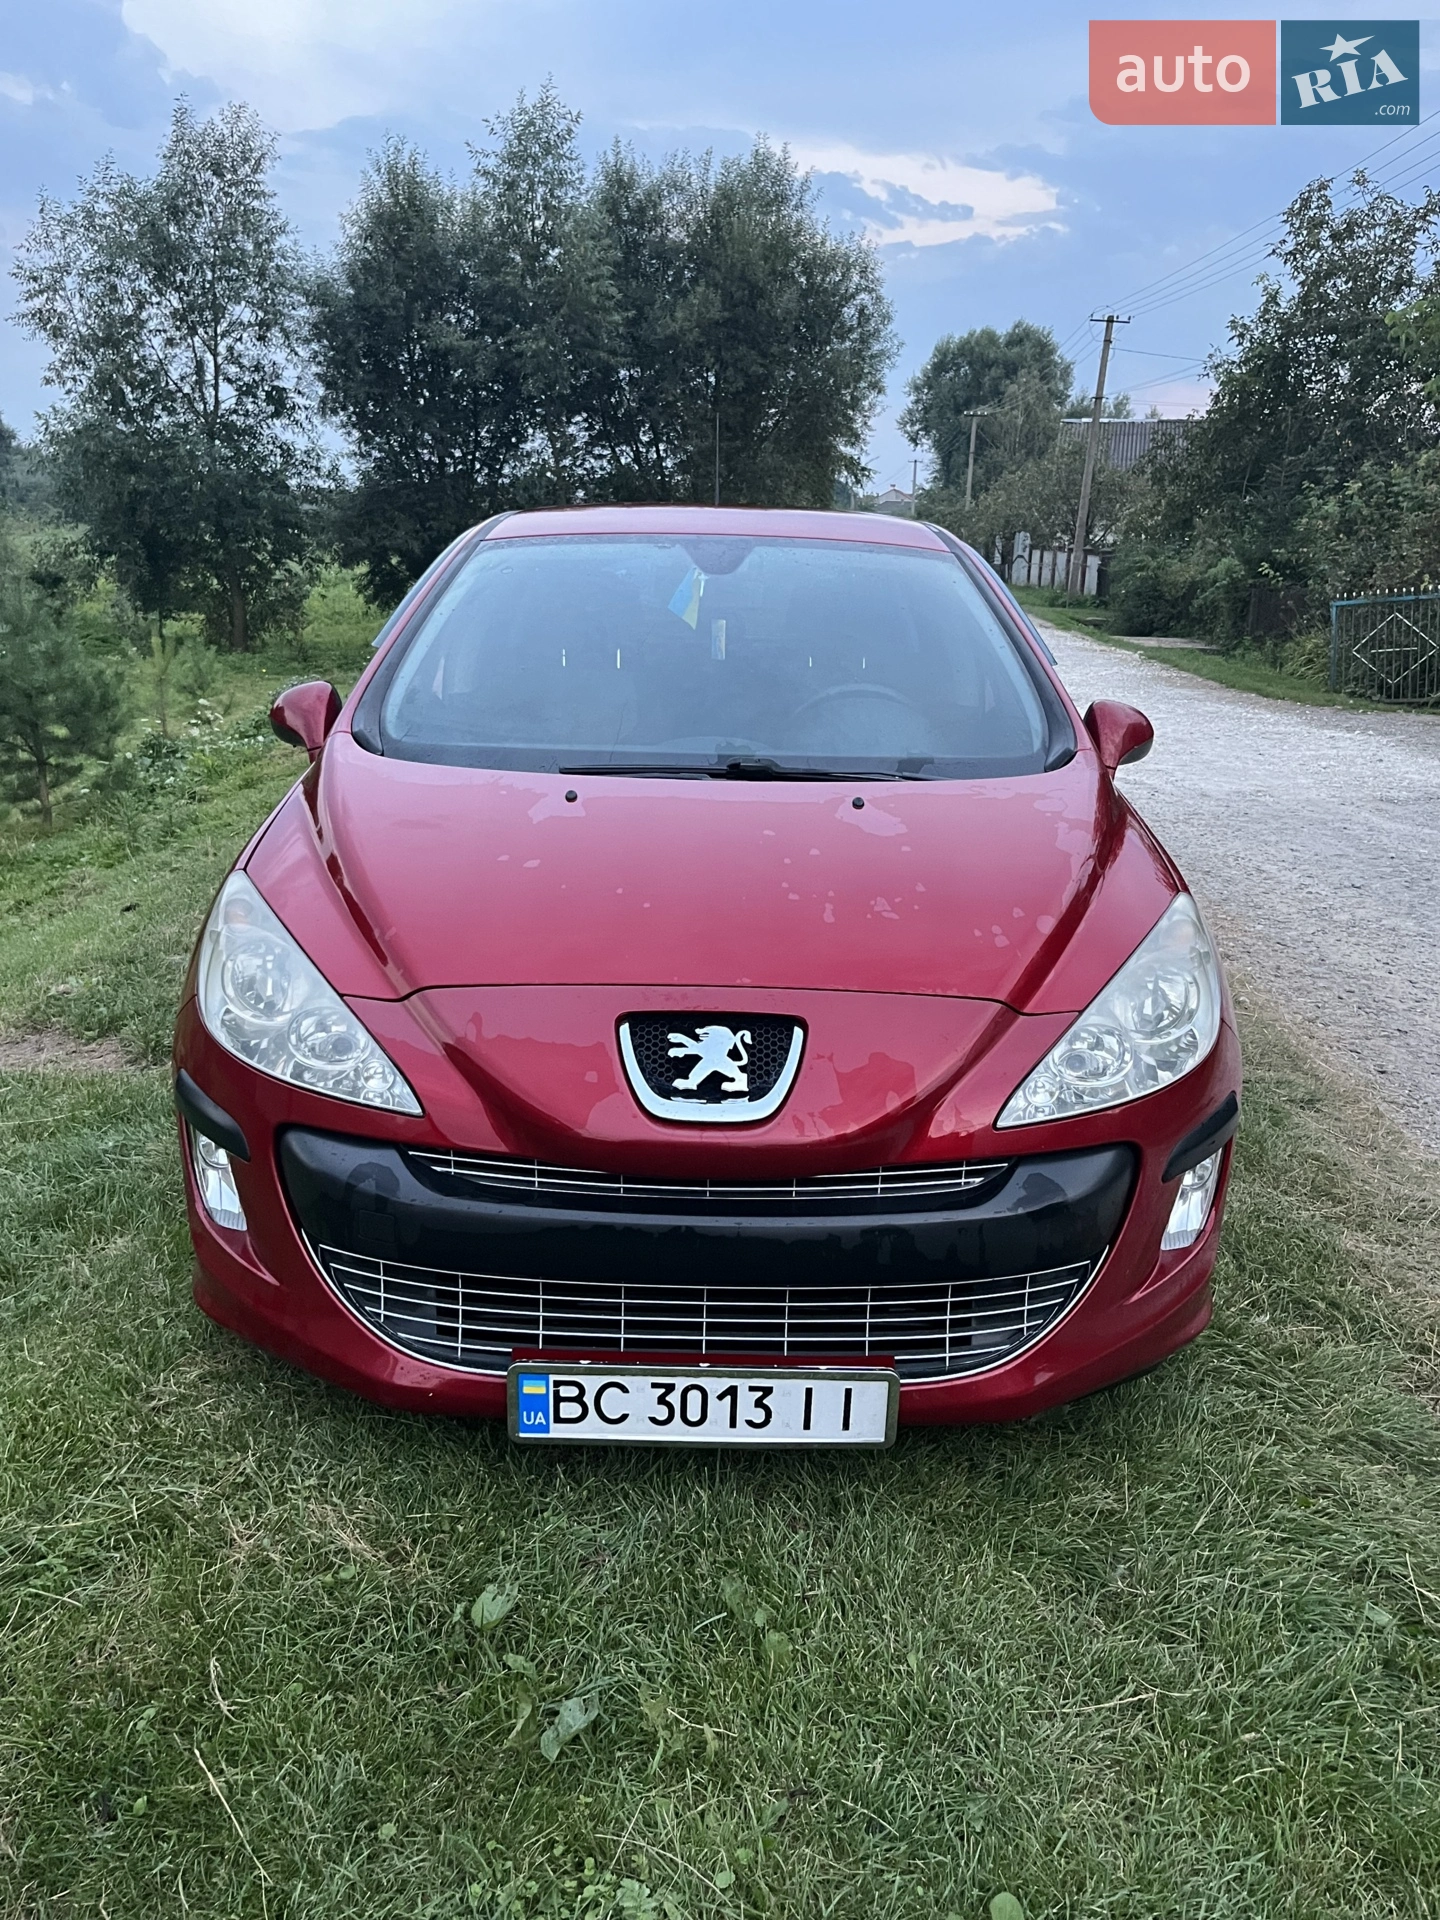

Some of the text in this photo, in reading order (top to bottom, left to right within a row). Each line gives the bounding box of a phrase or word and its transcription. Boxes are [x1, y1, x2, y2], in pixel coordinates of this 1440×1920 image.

[522, 1411, 546, 1426] UA
[552, 1379, 630, 1425] BC
[647, 1382, 774, 1430] 3013
